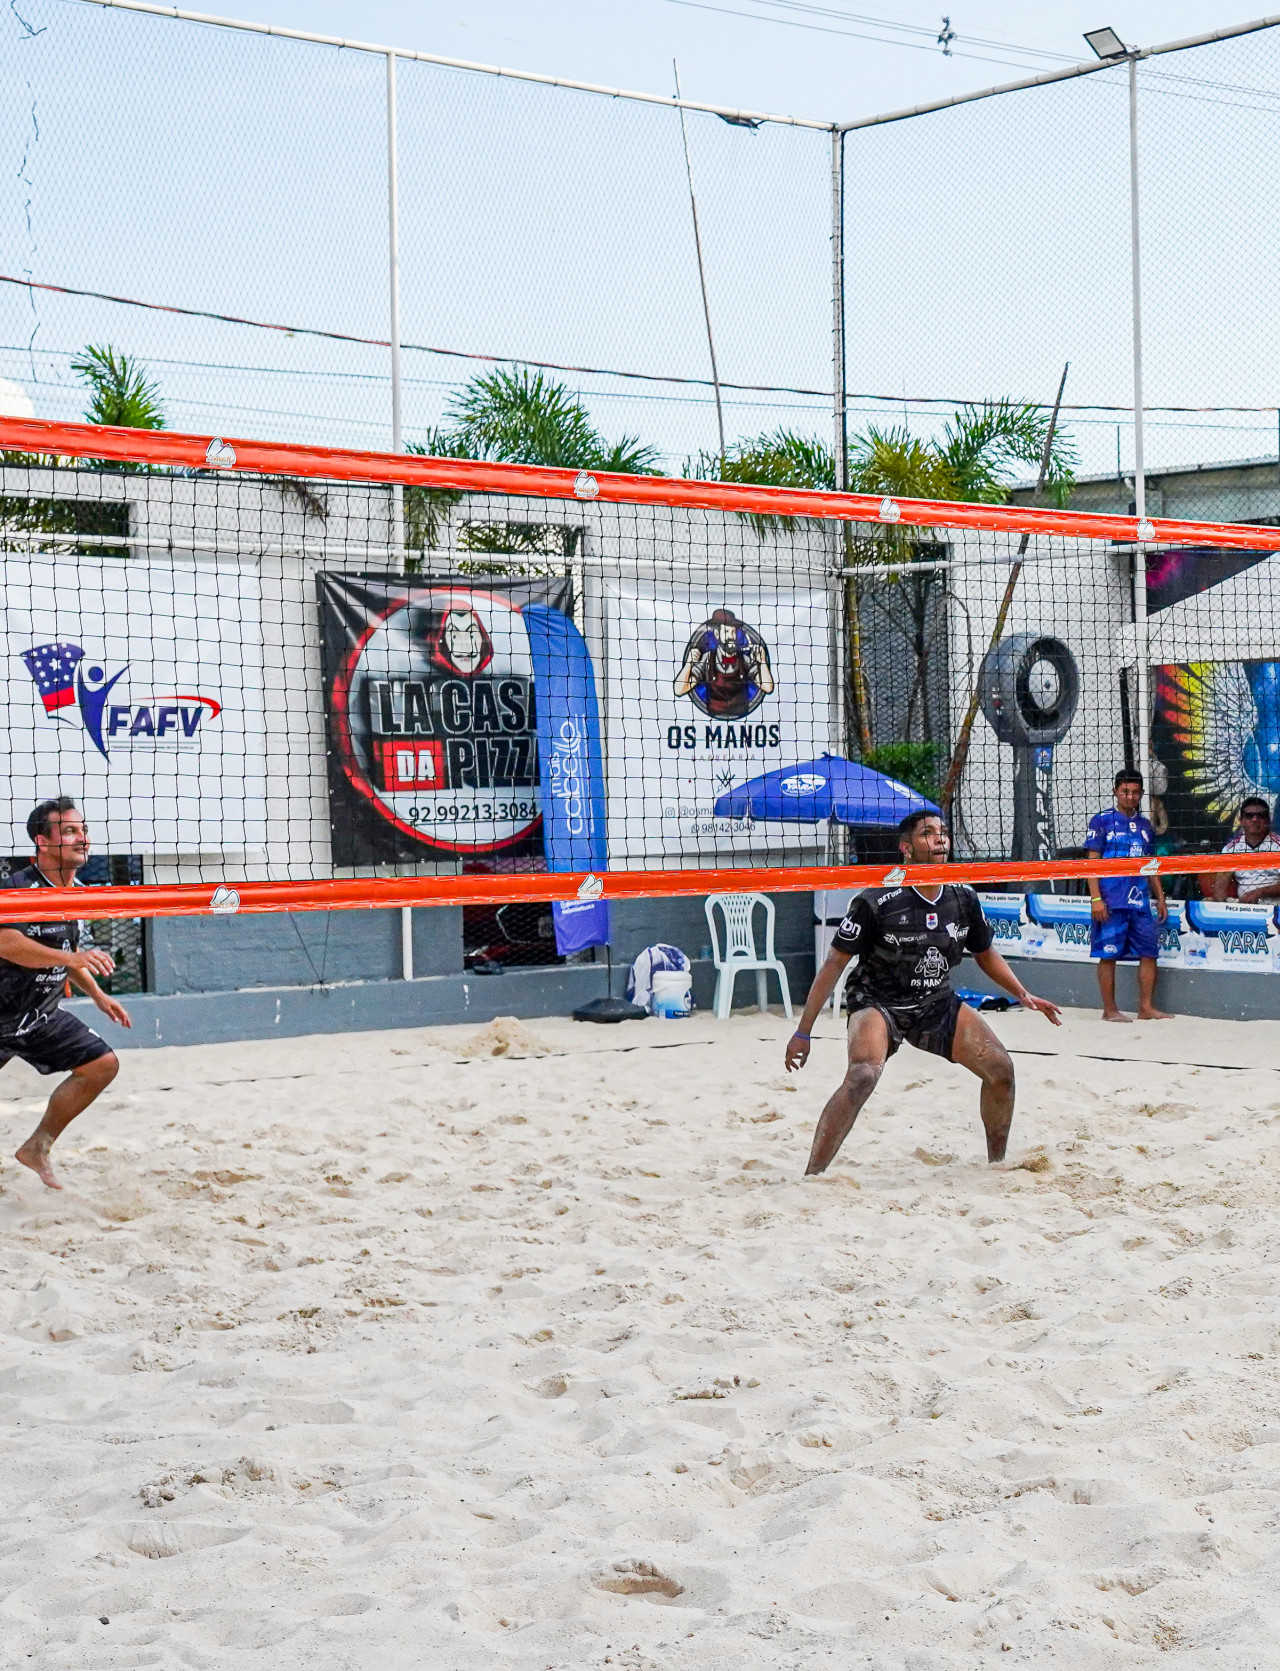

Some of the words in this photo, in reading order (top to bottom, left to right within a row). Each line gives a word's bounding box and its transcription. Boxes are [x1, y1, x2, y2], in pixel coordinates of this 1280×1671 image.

[377, 680, 434, 735] LA
[108, 706, 204, 737] FAFV
[667, 725, 696, 749] OS
[705, 724, 780, 749] MANOS
[396, 750, 435, 782] DA
[447, 737, 540, 790] PIZZ
[549, 751, 562, 795] mais
[553, 718, 583, 835] cabello
[987, 919, 1022, 940] ARA
[1054, 922, 1091, 945] YAR
[1157, 928, 1181, 951] RA
[1218, 931, 1269, 954] YARA
[911, 979, 921, 987] OS
